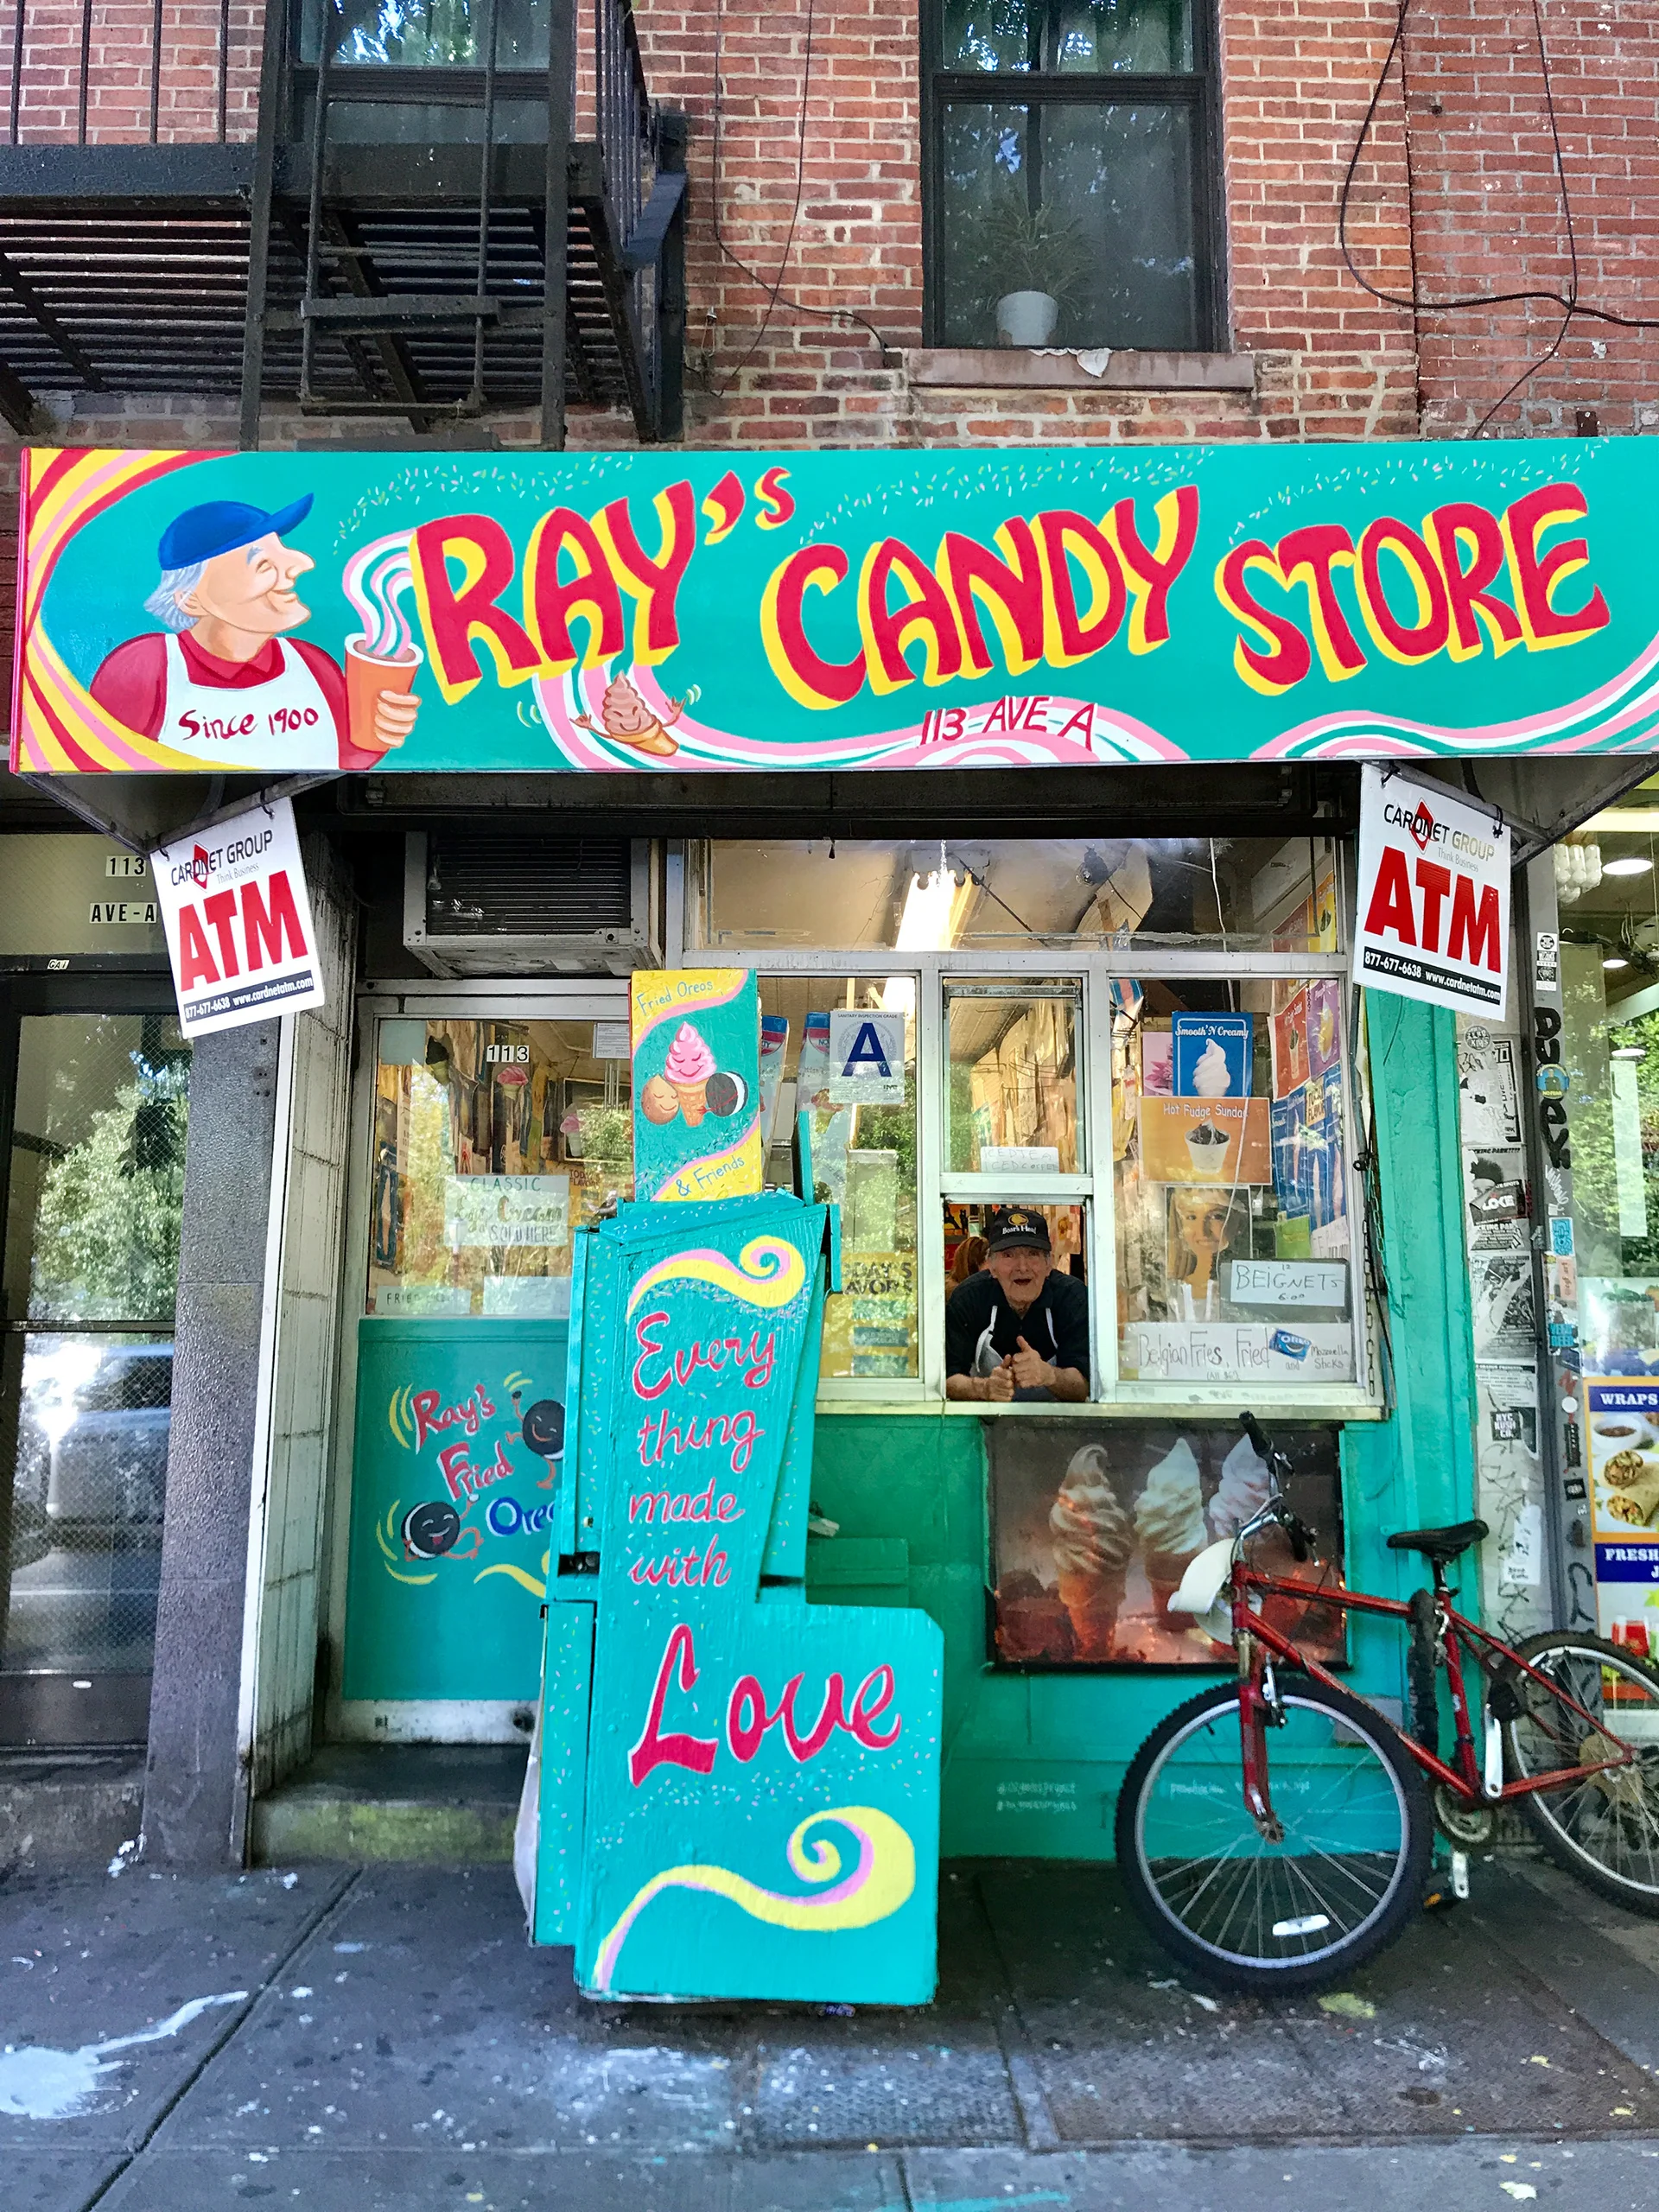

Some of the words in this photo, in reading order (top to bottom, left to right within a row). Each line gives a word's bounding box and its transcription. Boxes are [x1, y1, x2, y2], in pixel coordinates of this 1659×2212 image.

[409, 465, 797, 705] RAY'S
[760, 484, 1199, 710] CANDY
[1213, 481, 1611, 696] STORE
[178, 709, 258, 741] Since
[268, 707, 320, 736] 1900
[919, 707, 970, 746] 113
[981, 694, 1054, 735] AVE
[1056, 702, 1098, 753] A
[1383, 803, 1451, 844] CARDNET
[1452, 830, 1496, 862] GROUP
[109, 856, 146, 876] 113
[170, 848, 224, 887] CARDNET
[226, 829, 274, 865] GROUP
[216, 870, 234, 885] Think
[233, 862, 260, 880] Business
[1437, 846, 1455, 864] Think
[1454, 855, 1479, 873] Business
[179, 869, 309, 993] ATM
[1363, 845, 1502, 975] ATM
[184, 995, 232, 1020] 877-677-6638
[232, 976, 315, 1007] www.cardnetatm.com
[636, 990, 673, 1017] Fried
[676, 978, 714, 1000] Oreos
[1364, 951, 1422, 979] 877-677-6638
[1425, 969, 1502, 1001] www.cardnetatm.com
[488, 1046, 530, 1062] 113
[841, 1021, 893, 1077] A
[1217, 1026, 1249, 1040] Creamy
[1163, 1102, 1180, 1116] Hot
[1183, 1103, 1211, 1122] Fudge
[470, 1177, 542, 1192] CLASSIC
[675, 1179, 693, 1198] &
[693, 1154, 747, 1192] Friends
[632, 1311, 778, 1402] Every
[1139, 1333, 1188, 1376] Belgian
[1236, 1327, 1270, 1369] Fried
[410, 1383, 496, 1455] Ray's
[1599, 1392, 1659, 1406] WRAPS
[637, 1408, 766, 1474] thing
[435, 1440, 515, 1503] Fried
[627, 1478, 747, 1524] made
[626, 1534, 733, 1588] with
[1604, 1547, 1659, 1561] FRESH
[627, 1622, 903, 1789] Love
